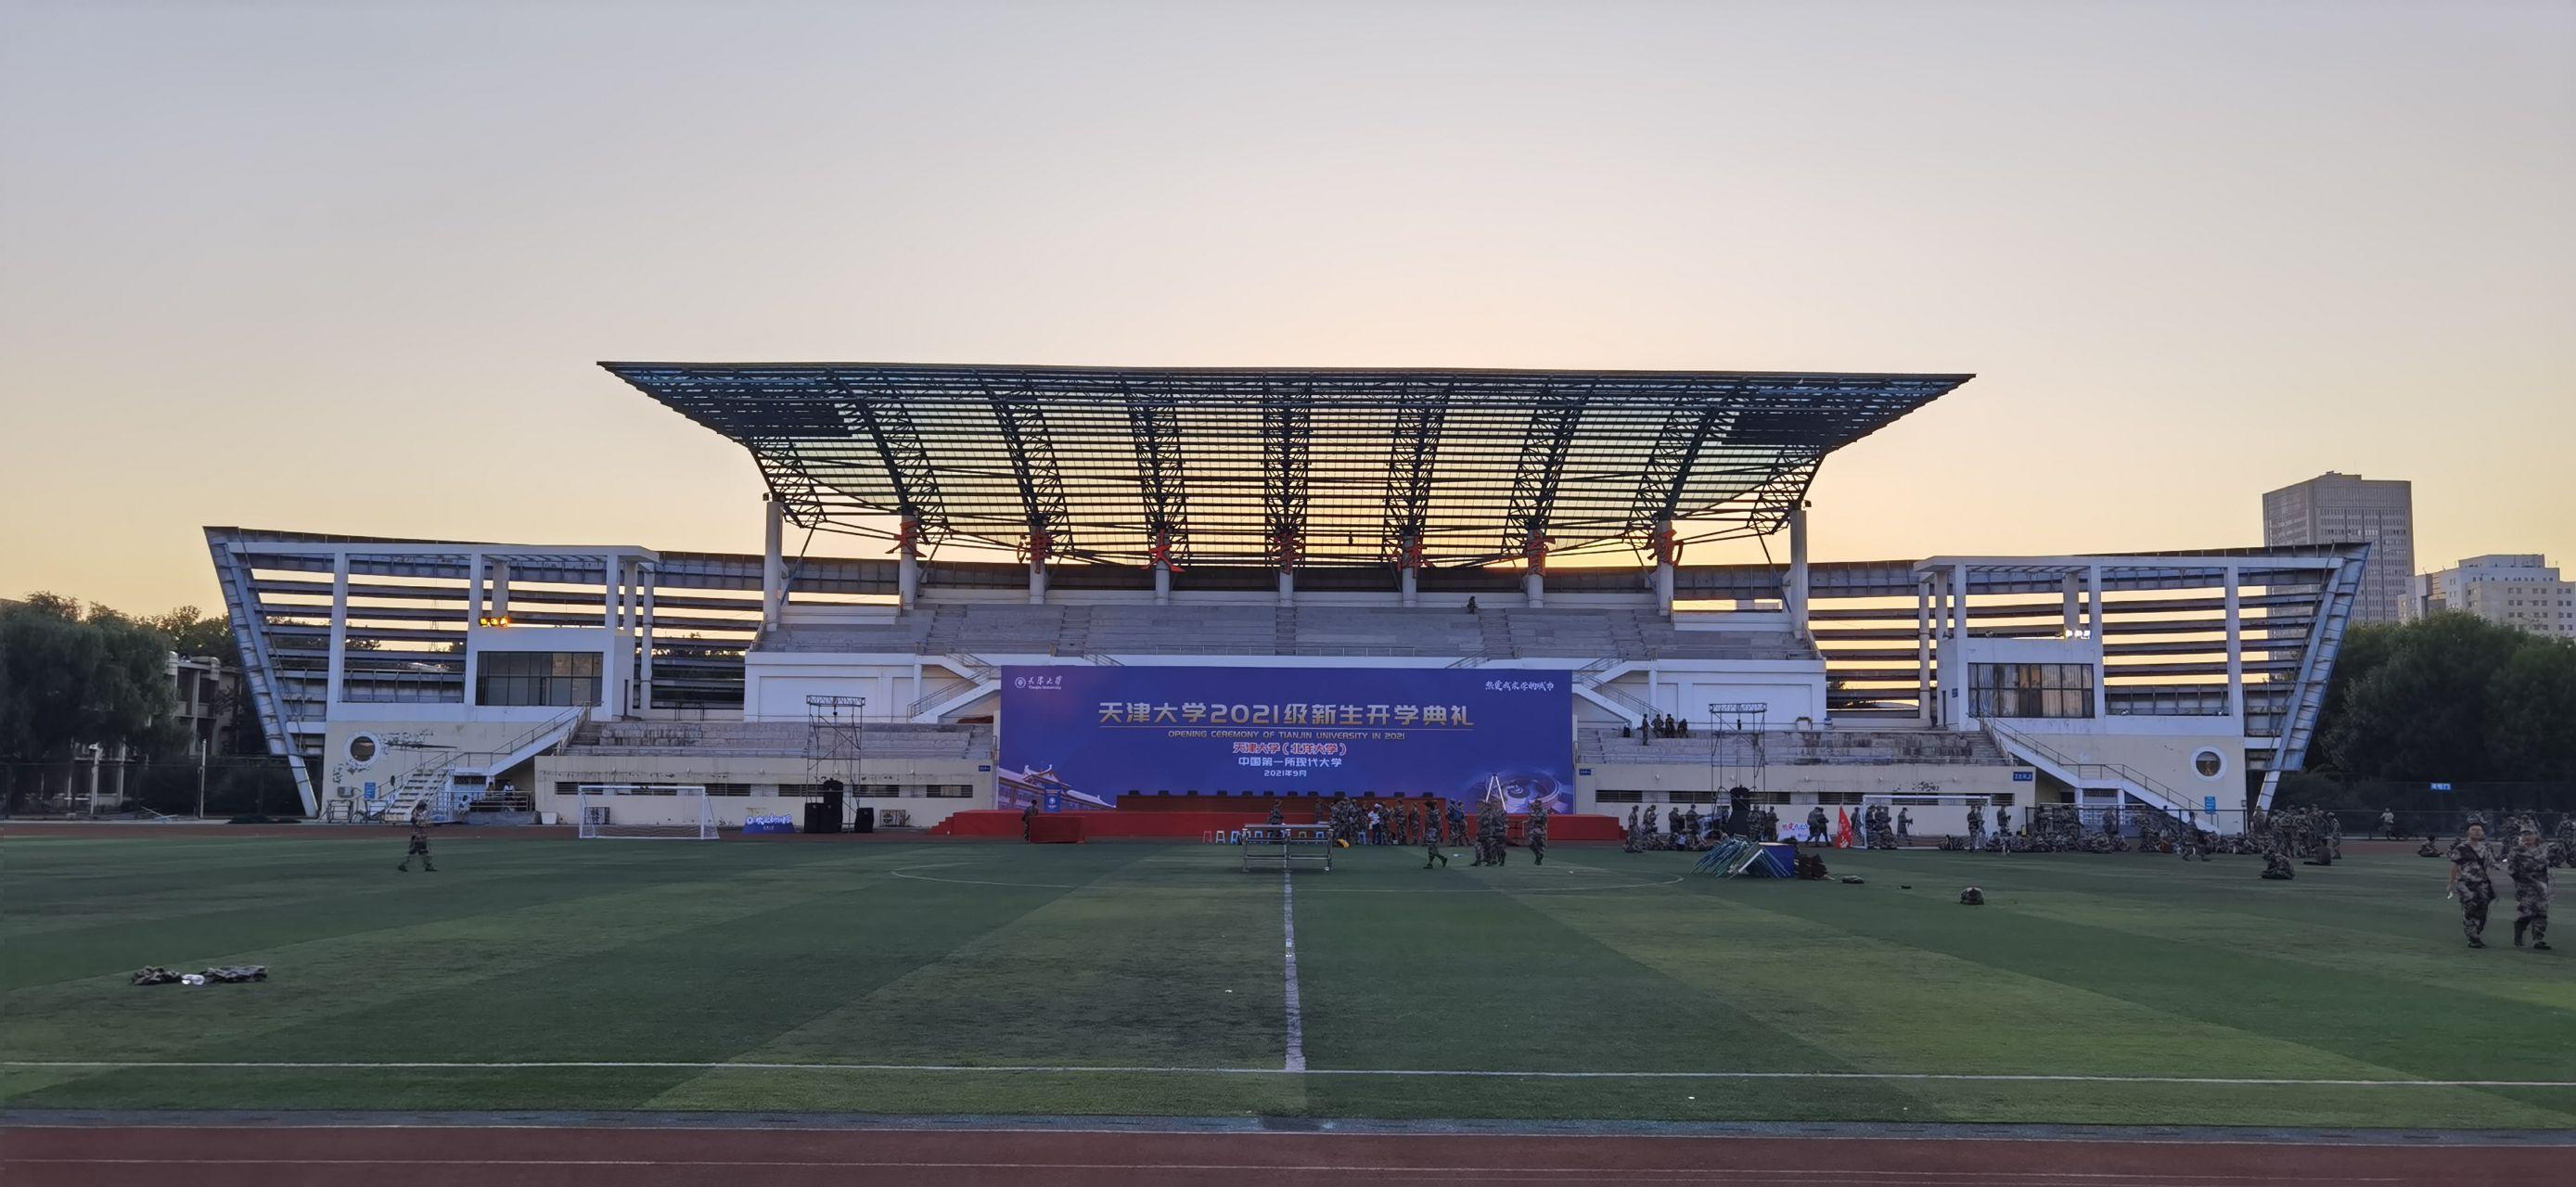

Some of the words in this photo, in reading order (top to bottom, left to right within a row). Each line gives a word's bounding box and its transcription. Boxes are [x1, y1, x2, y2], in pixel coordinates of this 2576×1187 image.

[1098, 702, 1475, 725] 天津大学2021级新生开学典礼
[1168, 730, 1207, 738] OPENING
[1211, 731, 1259, 739] CEREMONY
[1262, 731, 1275, 739] OF
[1278, 731, 1312, 739] TIANJIN
[1316, 732, 1368, 740] UNIVERSITY
[1238, 757, 1342, 767] 中国第一所现代大学
